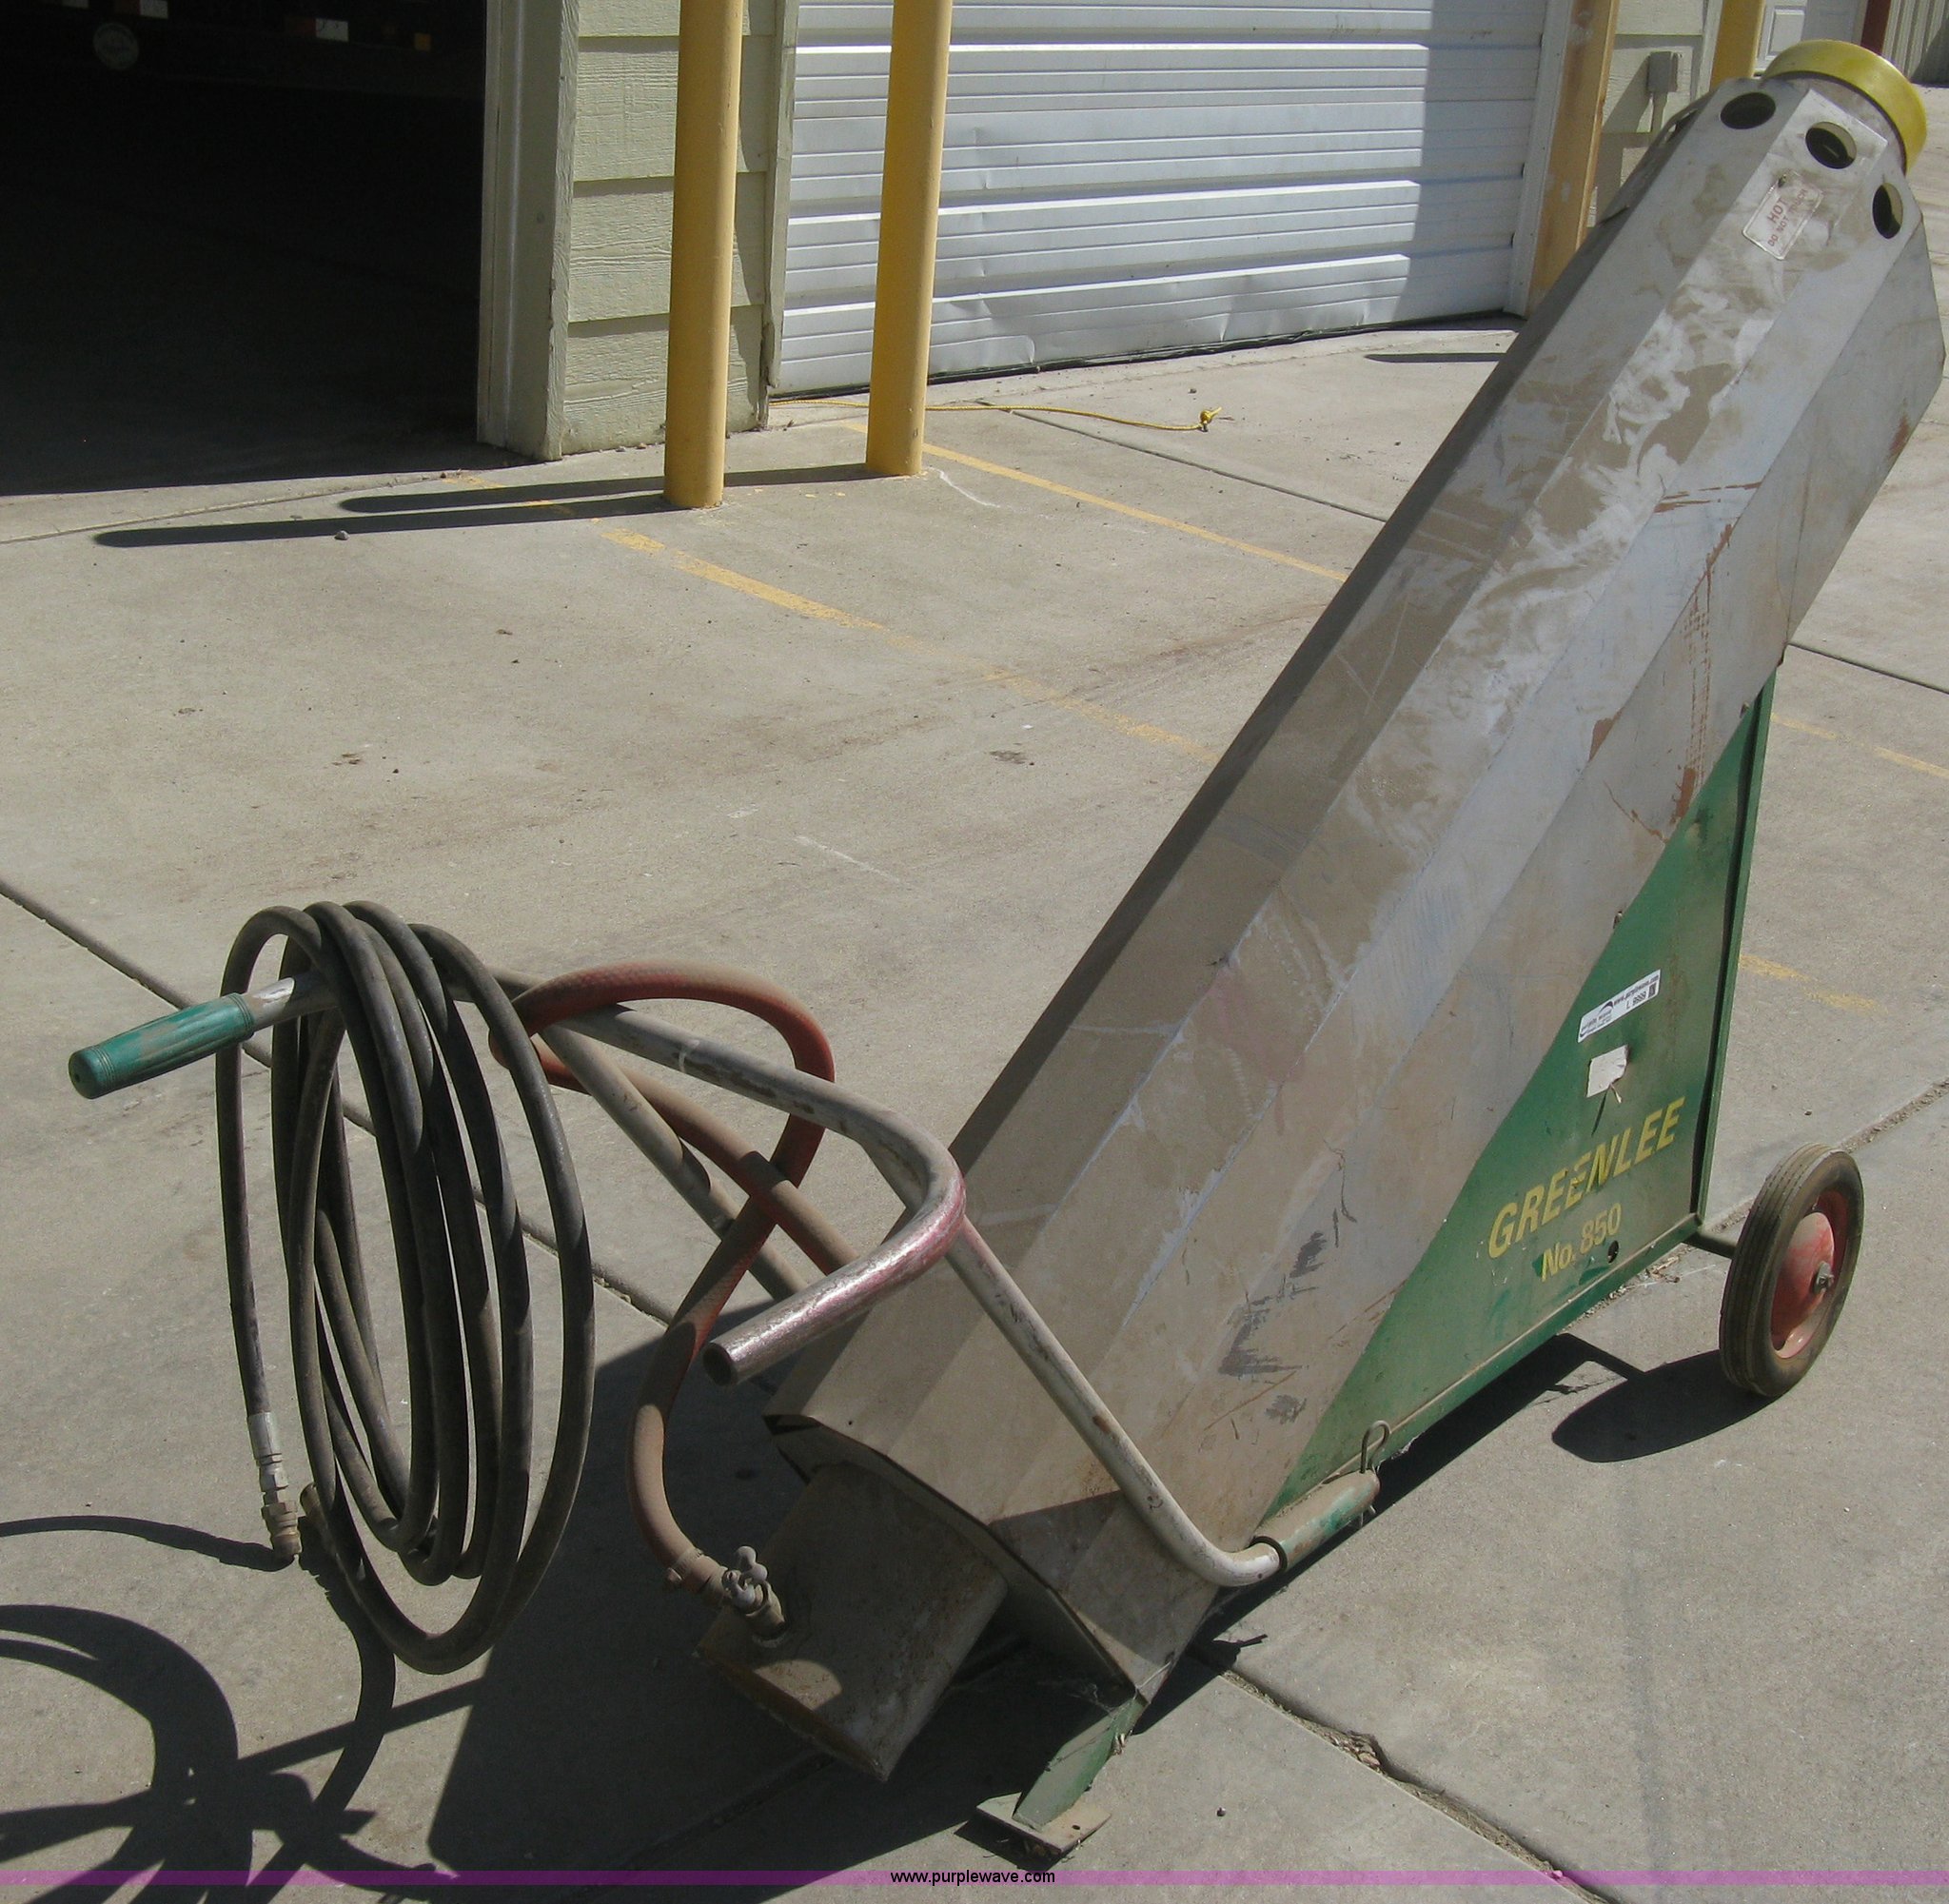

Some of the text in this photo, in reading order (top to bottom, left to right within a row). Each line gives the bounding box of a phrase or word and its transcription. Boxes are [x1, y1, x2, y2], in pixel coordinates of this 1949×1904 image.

[1767, 198, 1789, 224] HOT
[1767, 188, 1808, 246] DO NOT TOUCH
[1488, 1096, 1685, 1259] GREENLEE
[1542, 1203, 1622, 1283] No. 850
